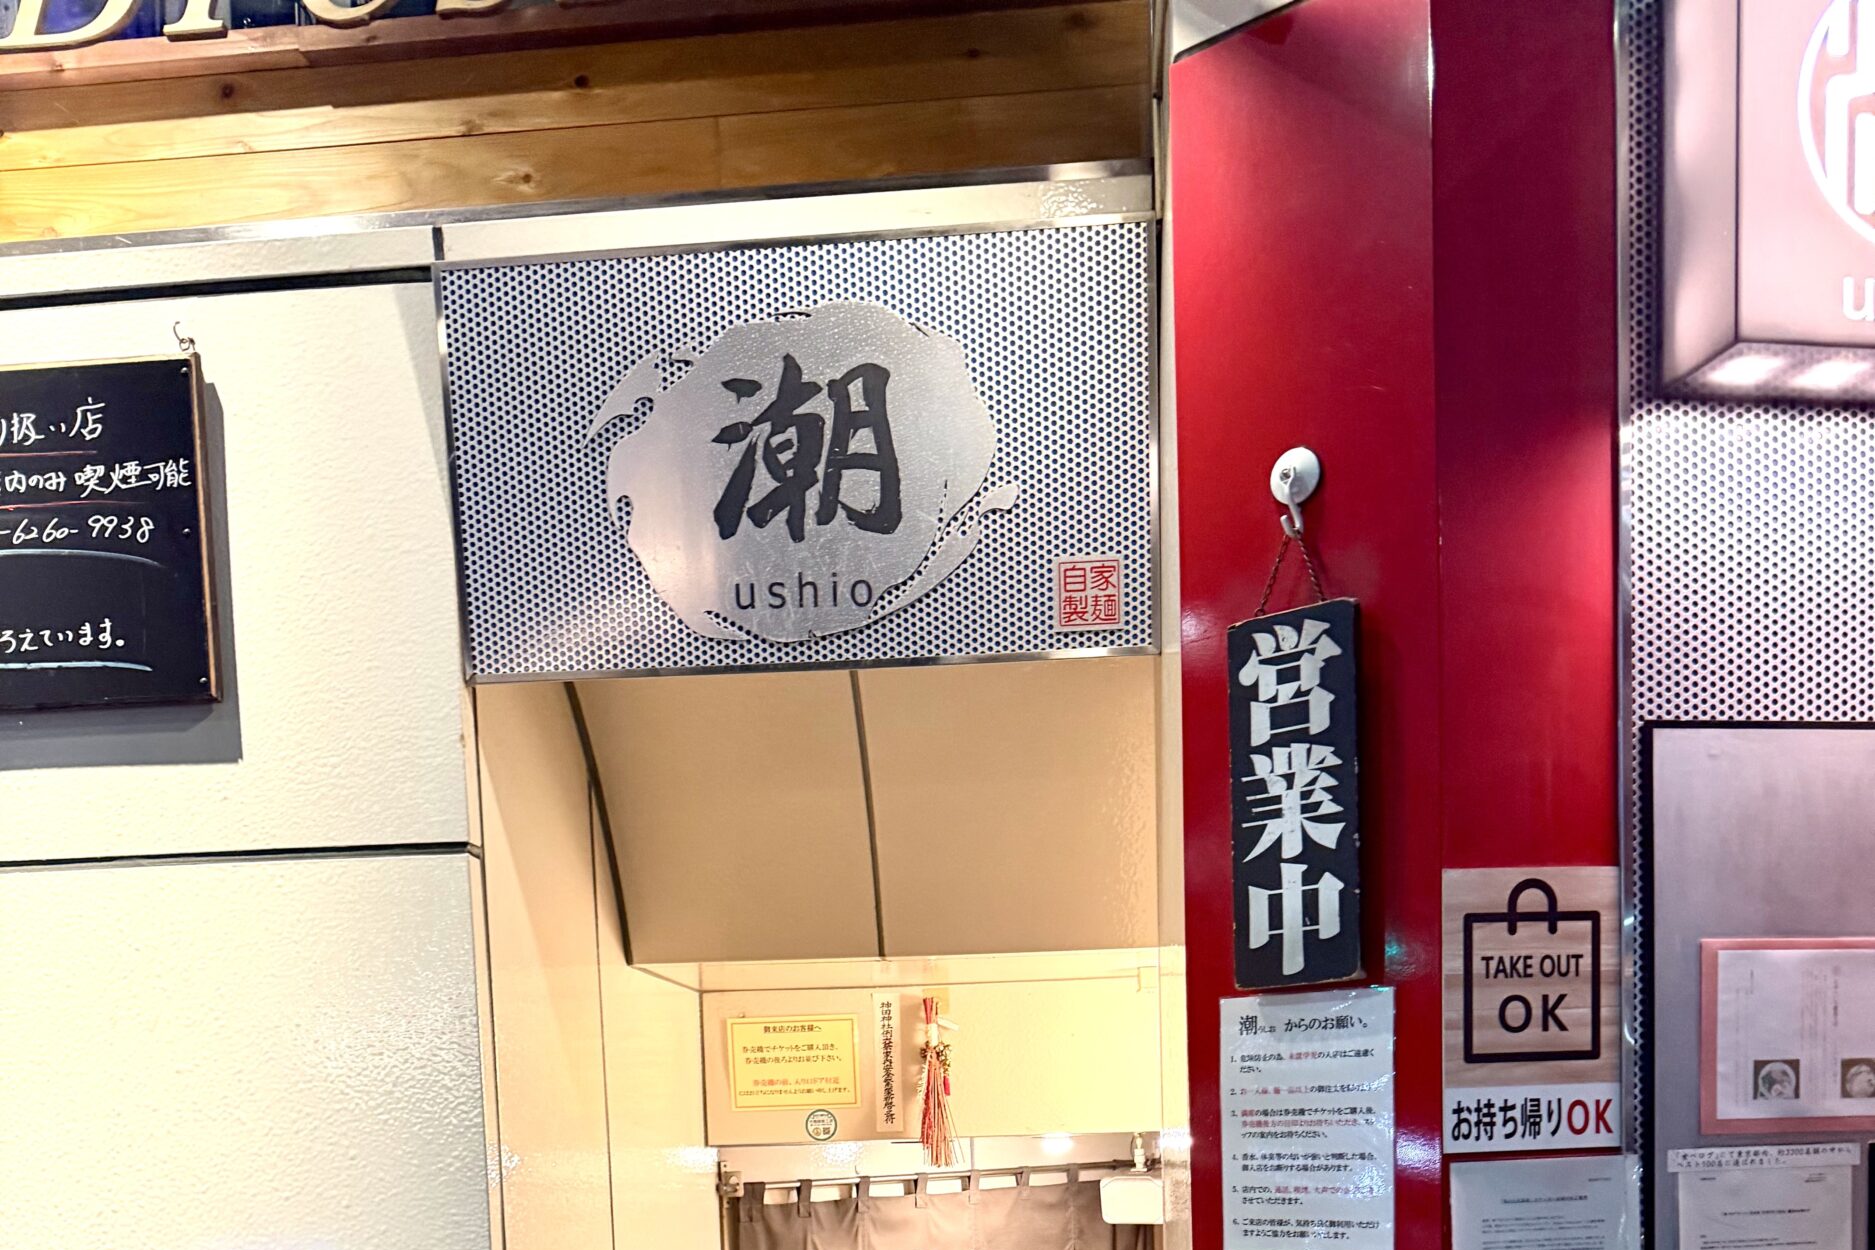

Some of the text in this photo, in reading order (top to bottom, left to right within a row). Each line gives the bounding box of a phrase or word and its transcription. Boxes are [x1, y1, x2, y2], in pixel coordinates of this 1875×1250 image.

[712, 353, 902, 543] 潮
[0, 459, 192, 498] 内のみ喫煙可能
[734, 571, 873, 611] ushio
[1238, 618, 1345, 976] 営業中
[1480, 954, 1584, 979] TAKE OUT
[1498, 993, 1569, 1033] OK
[1451, 1097, 1613, 1142] お持ち帰りOK
